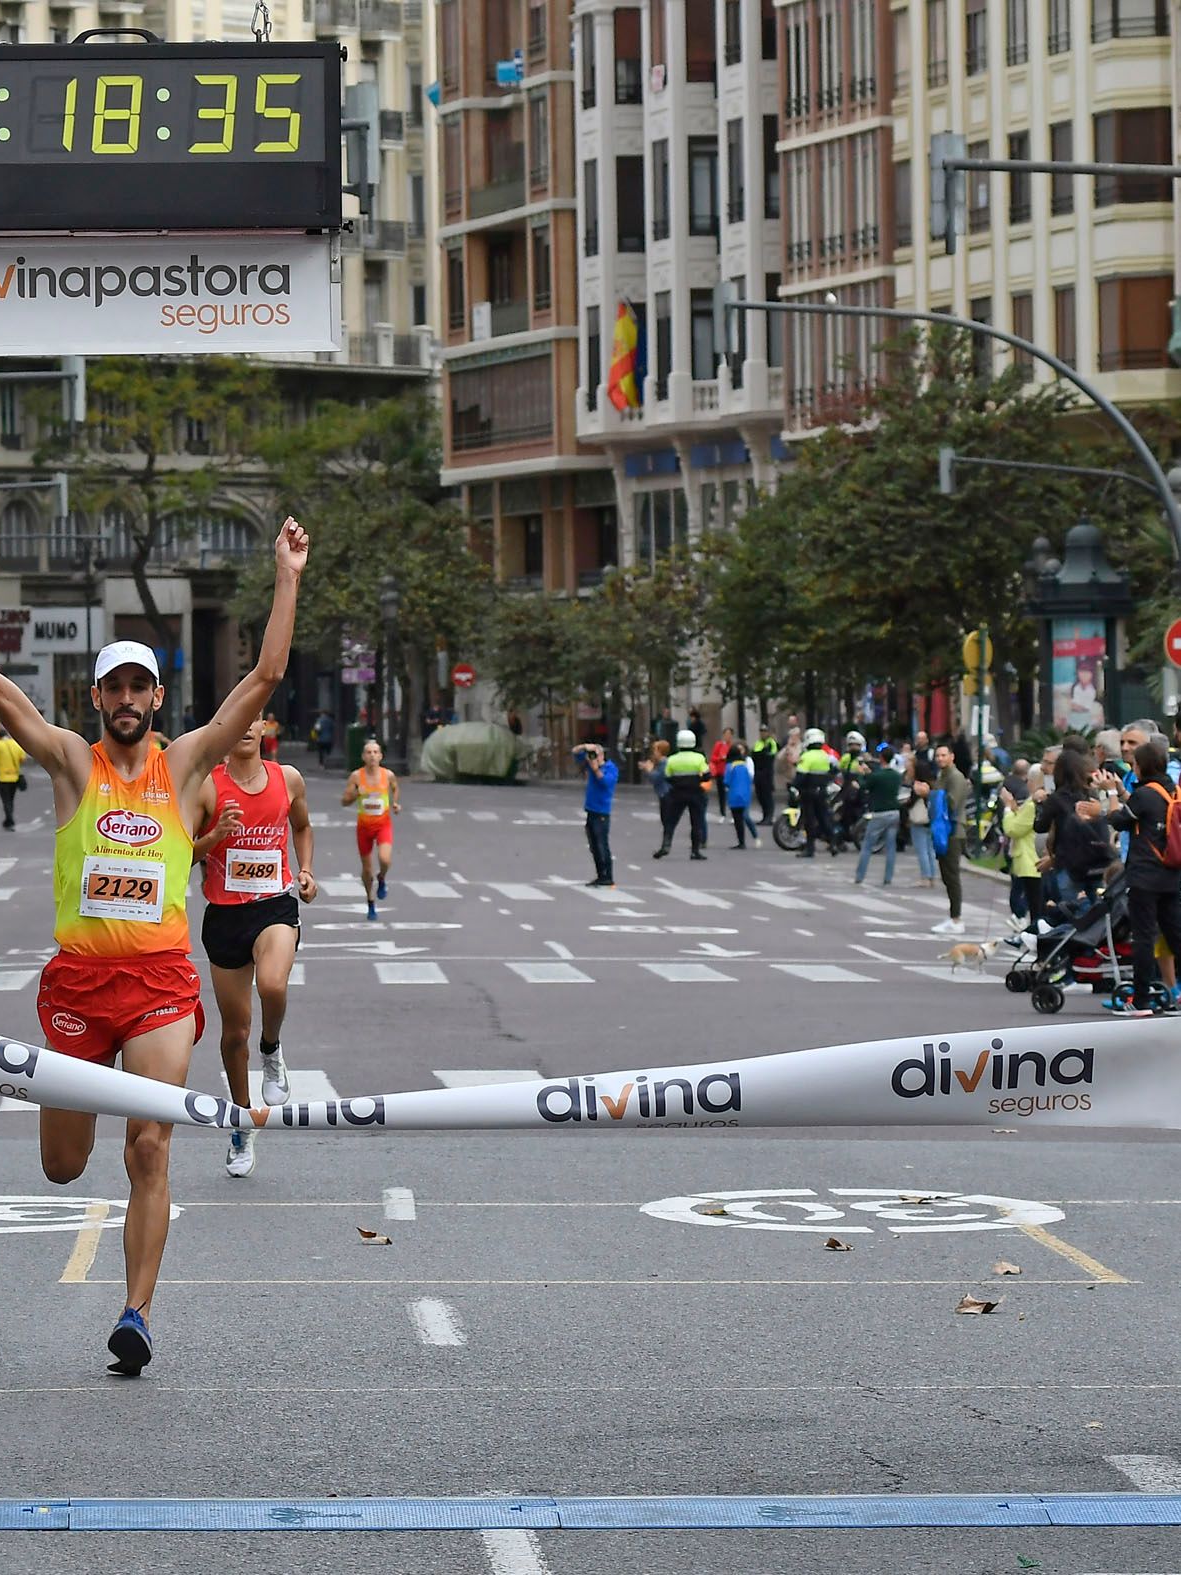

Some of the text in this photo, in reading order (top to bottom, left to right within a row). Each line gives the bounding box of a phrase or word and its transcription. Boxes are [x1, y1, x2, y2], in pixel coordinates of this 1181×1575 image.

[160, 302, 290, 334] seguros
[102, 816, 157, 837] Serrano
[93, 845, 164, 860] Alimentos de Hoy
[235, 863, 275, 879] 2489
[93, 876, 153, 901] 2129
[53, 1016, 84, 1032] Serrano
[891, 1037, 1095, 1098] divina
[536, 1072, 741, 1123] divina
[988, 1093, 1092, 1117] seguros
